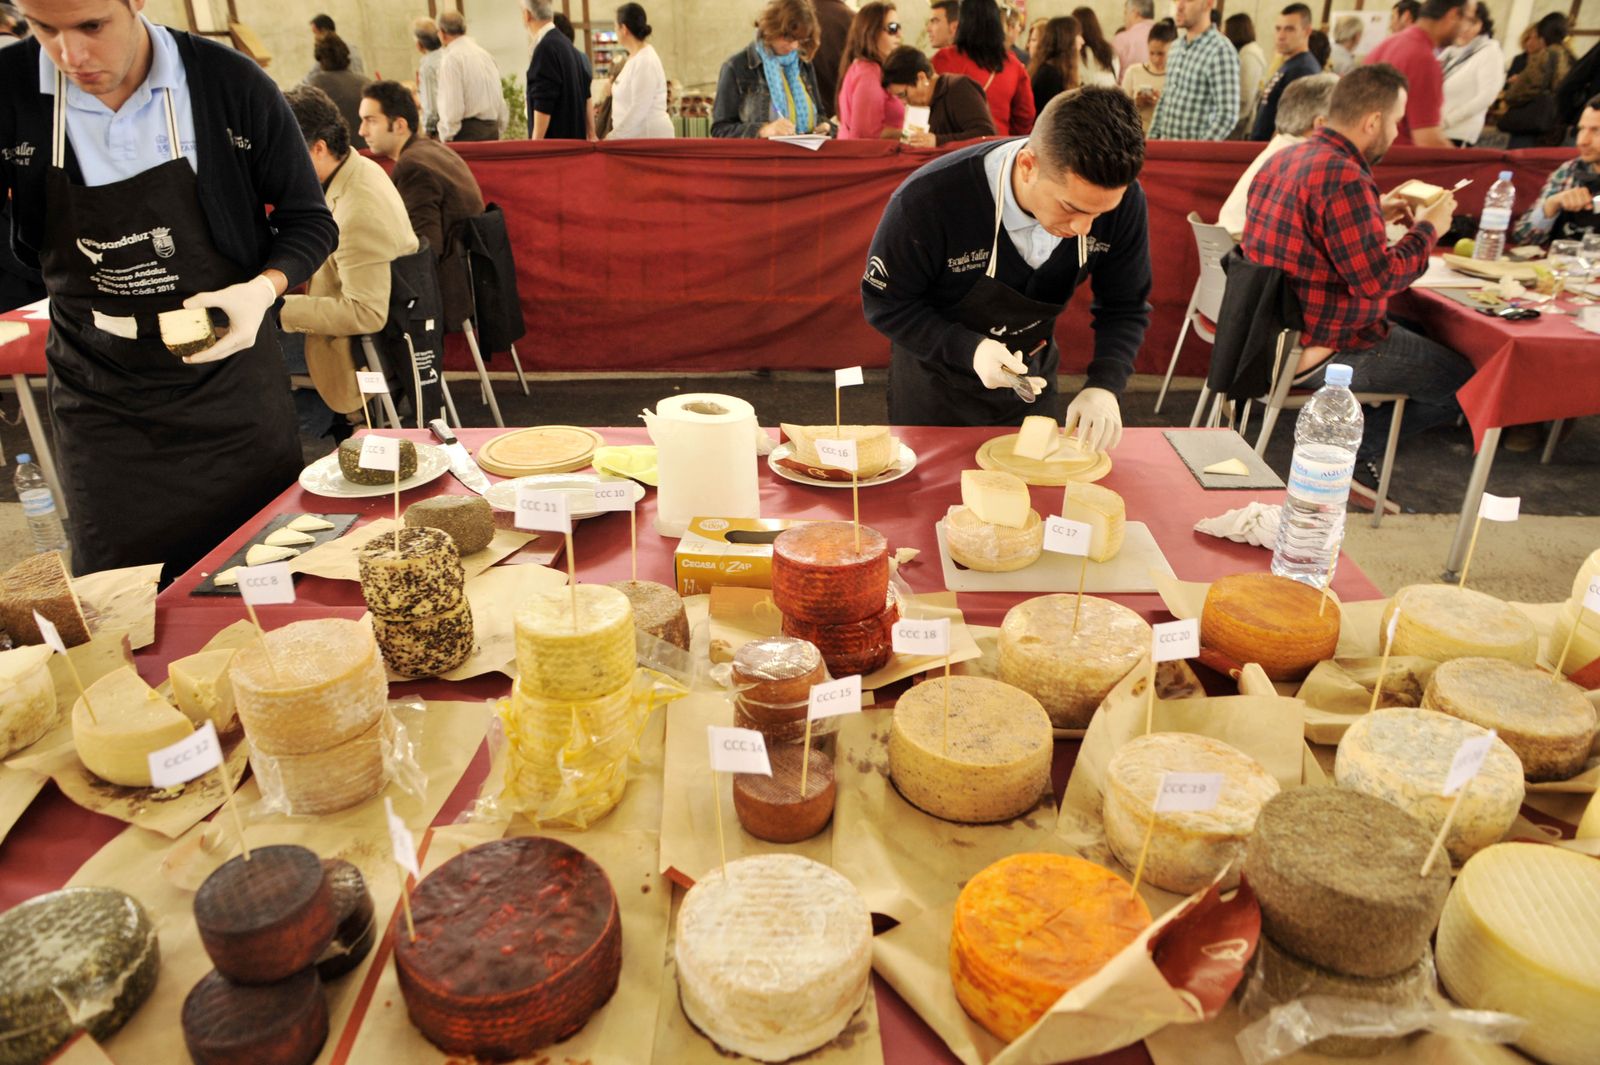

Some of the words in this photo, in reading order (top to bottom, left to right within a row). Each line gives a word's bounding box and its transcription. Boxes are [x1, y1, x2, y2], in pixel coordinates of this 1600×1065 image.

[135, 267, 167, 278] Andaluz
[128, 274, 180, 288] tradicionales
[156, 283, 176, 294] 2015
[838, 449, 849, 458] 16
[594, 489, 612, 499] CCC
[614, 489, 625, 498] 10
[520, 499, 541, 512] CCC
[544, 501, 557, 513] 11
[1066, 528, 1078, 537] 17
[681, 558, 716, 570] CEGASA
[726, 560, 752, 573] ZAP
[246, 576, 269, 588] CCC
[270, 575, 279, 586] 8
[899, 629, 921, 640] CCC
[924, 630, 937, 640] 18
[1159, 632, 1178, 644] CCC
[1179, 630, 1191, 641] 20
[816, 690, 837, 703] CCC
[840, 687, 852, 698] 15
[723, 739, 747, 752] CCC
[163, 748, 192, 769] CCC
[195, 740, 209, 756] 12
[1163, 783, 1188, 794] CCC
[1191, 783, 1207, 794] 19
